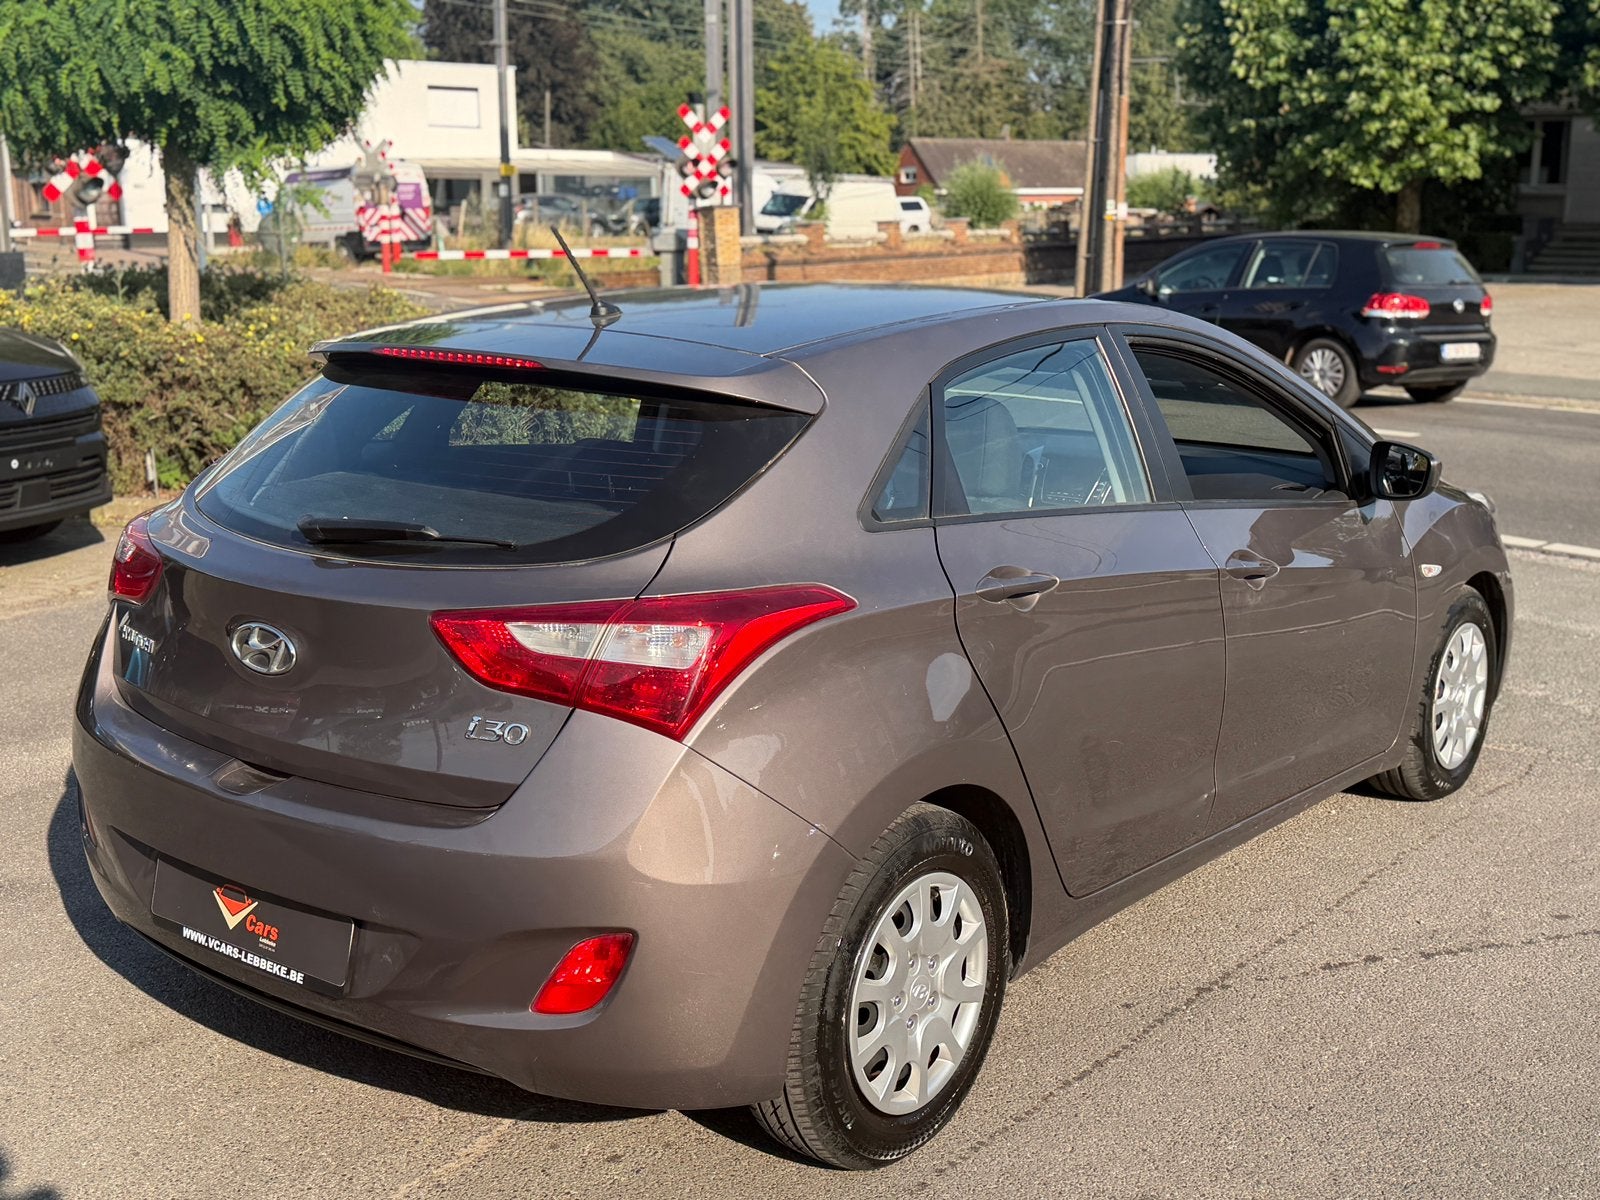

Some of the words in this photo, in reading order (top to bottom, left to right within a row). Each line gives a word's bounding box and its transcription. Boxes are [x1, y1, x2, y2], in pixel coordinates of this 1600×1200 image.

[465, 716, 529, 745] i30
[245, 914, 279, 941] Cars
[182, 926, 305, 985] WWW.VCARS-LEBBEKE.BE
